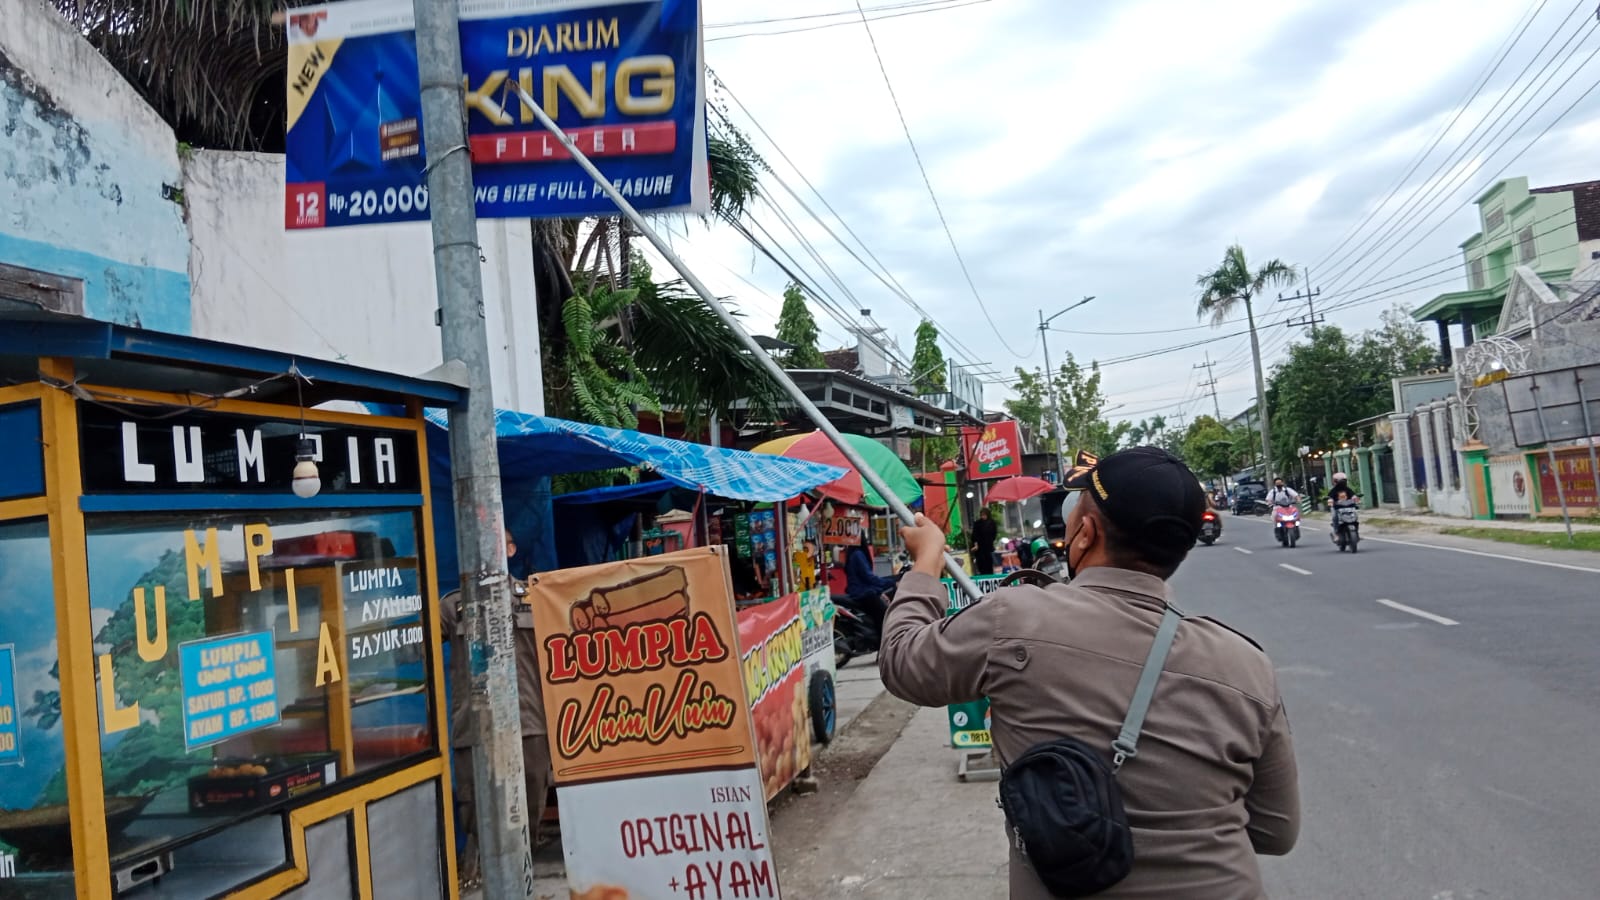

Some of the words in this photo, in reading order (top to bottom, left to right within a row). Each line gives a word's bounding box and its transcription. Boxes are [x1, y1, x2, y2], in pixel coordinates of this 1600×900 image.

[507, 17, 620, 58] DJARUM
[292, 46, 326, 96] NEW
[463, 55, 675, 126] KING
[296, 191, 320, 218] 12
[474, 186, 498, 204] NG
[503, 182, 537, 204] SIZE
[547, 179, 587, 201] FULL
[350, 566, 403, 593] LUMPIA
[201, 640, 261, 668] LUMPIA
[352, 628, 401, 660] SAYUR
[547, 614, 727, 682] LUMPIA
[189, 690, 226, 716] SAYUR
[190, 713, 224, 740] AYAM
[711, 785, 751, 803] ISIAN
[620, 811, 764, 859] ORIGINAL
